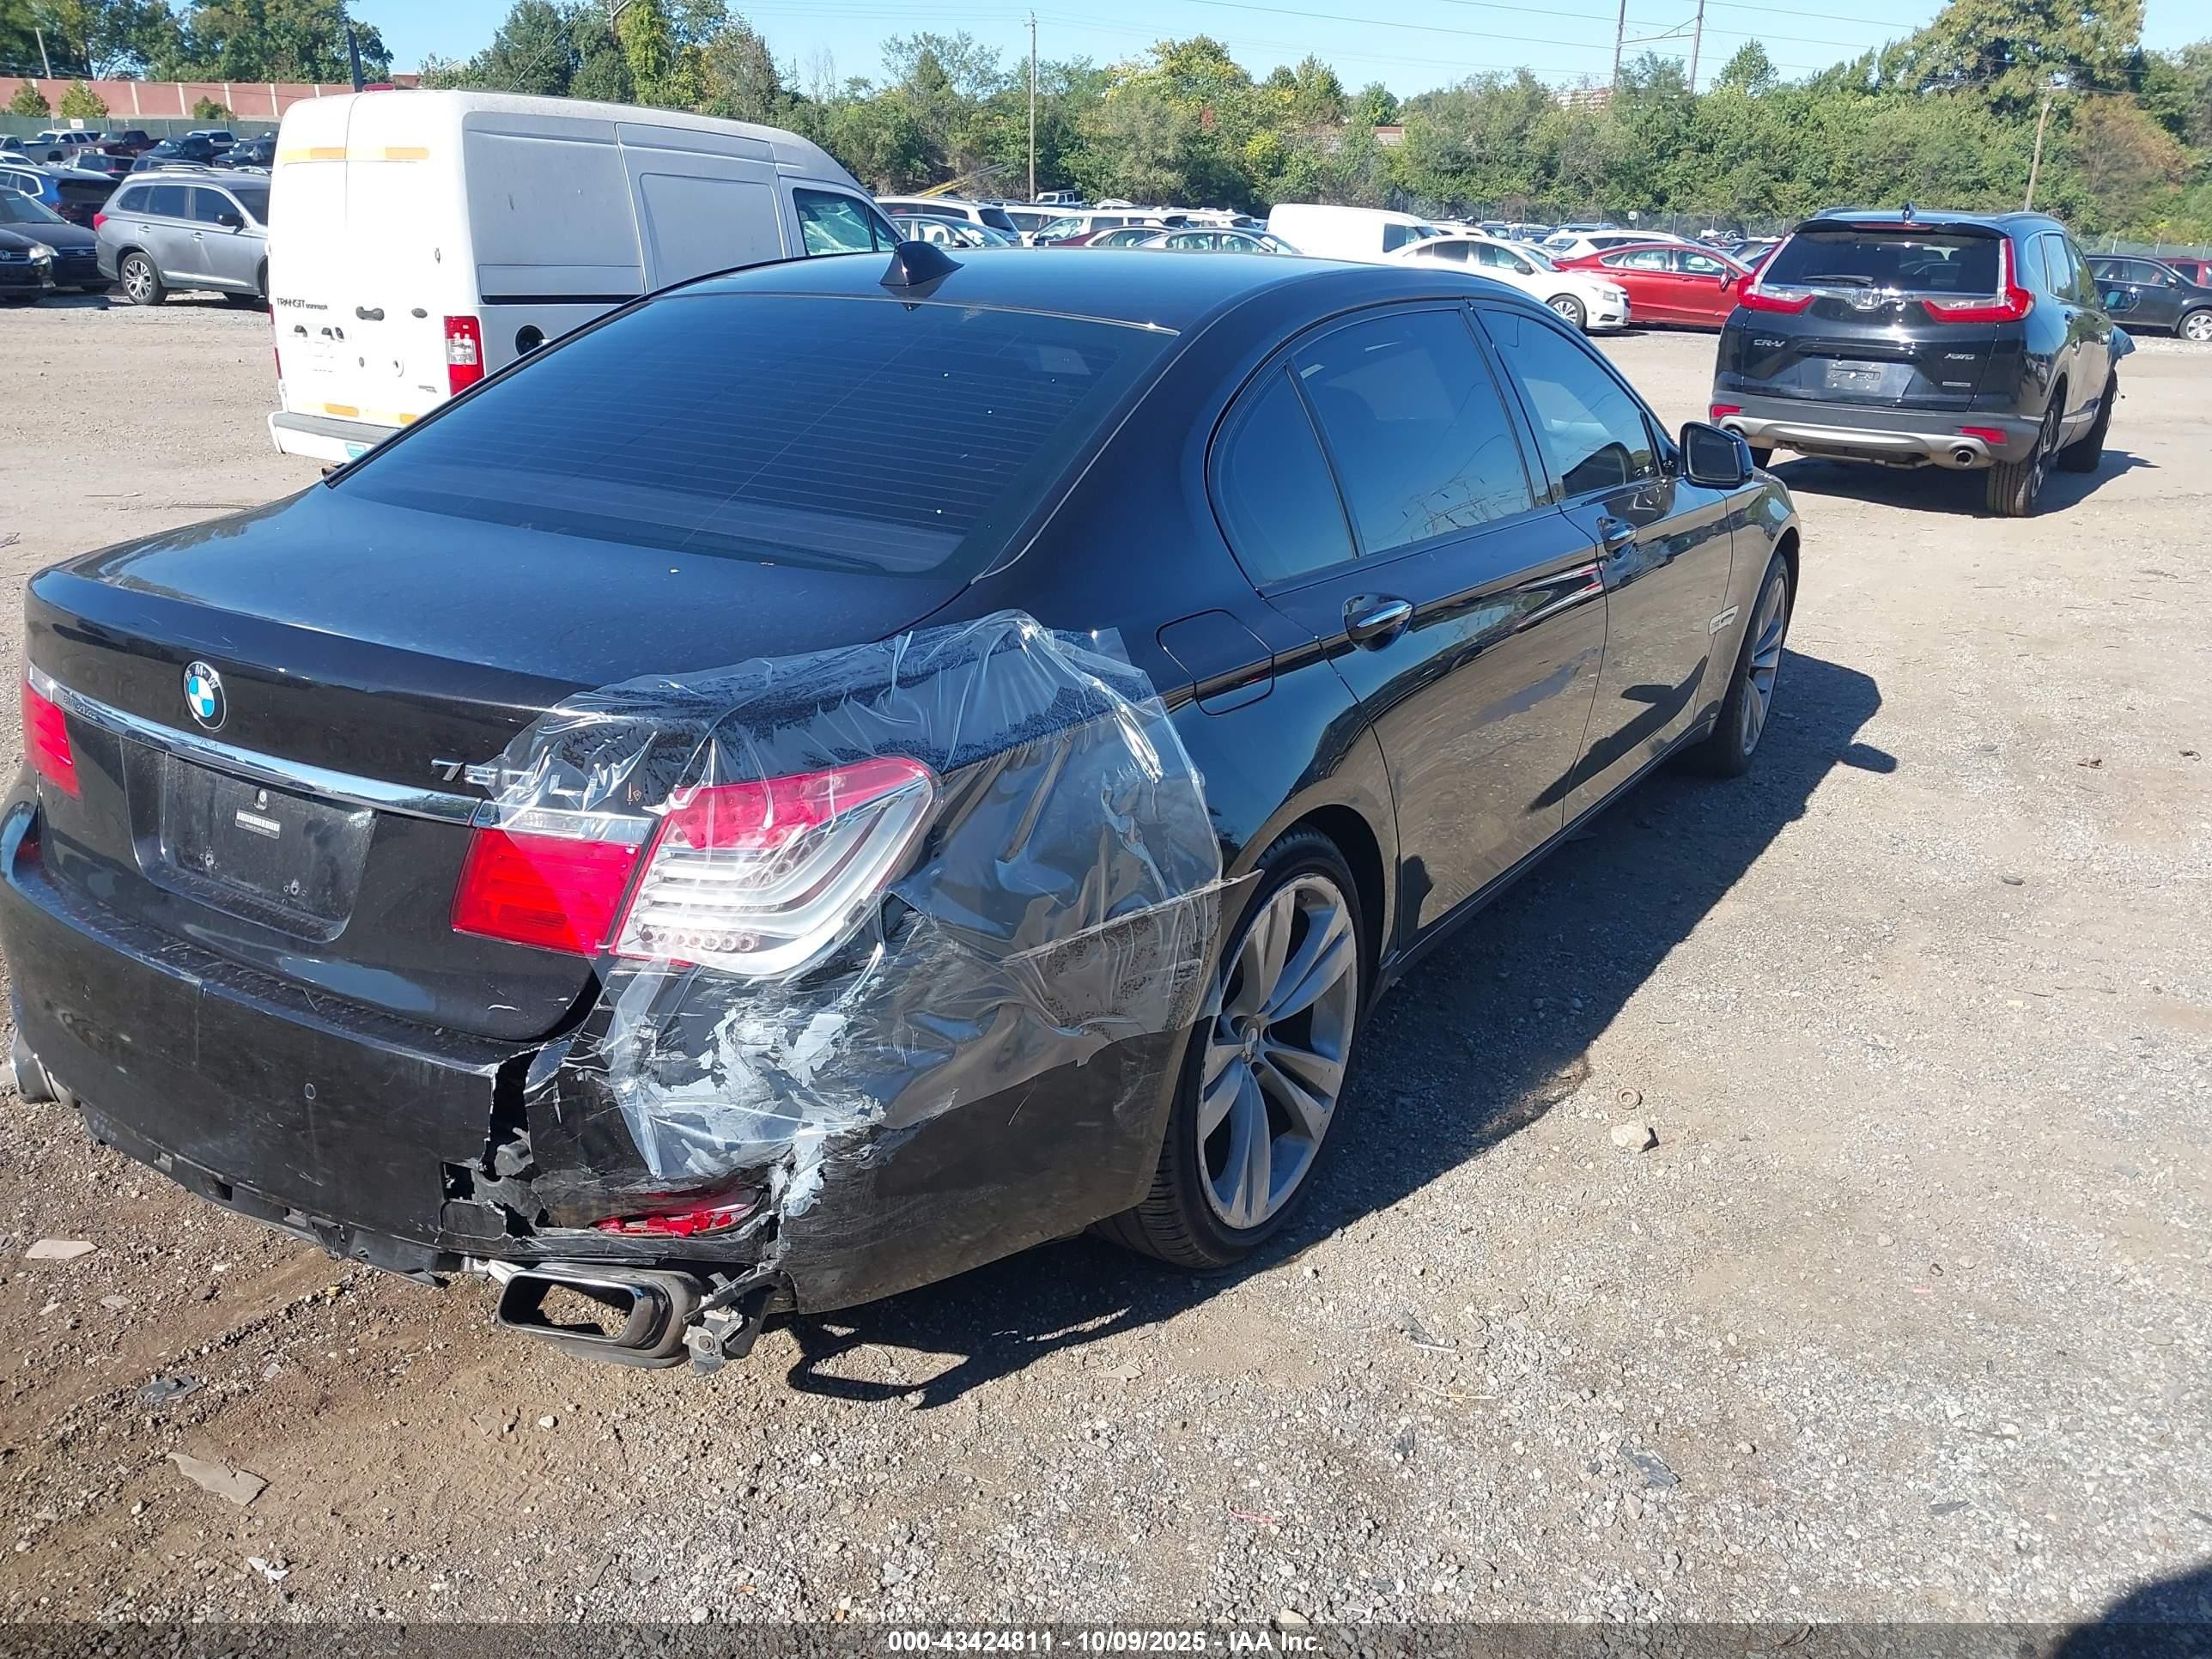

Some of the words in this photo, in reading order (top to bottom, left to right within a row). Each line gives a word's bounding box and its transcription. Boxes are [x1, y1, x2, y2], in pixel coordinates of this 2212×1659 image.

[276, 297, 306, 308] TRANSIT
[1753, 338, 1786, 348] CR-V
[185, 664, 220, 690] BMW
